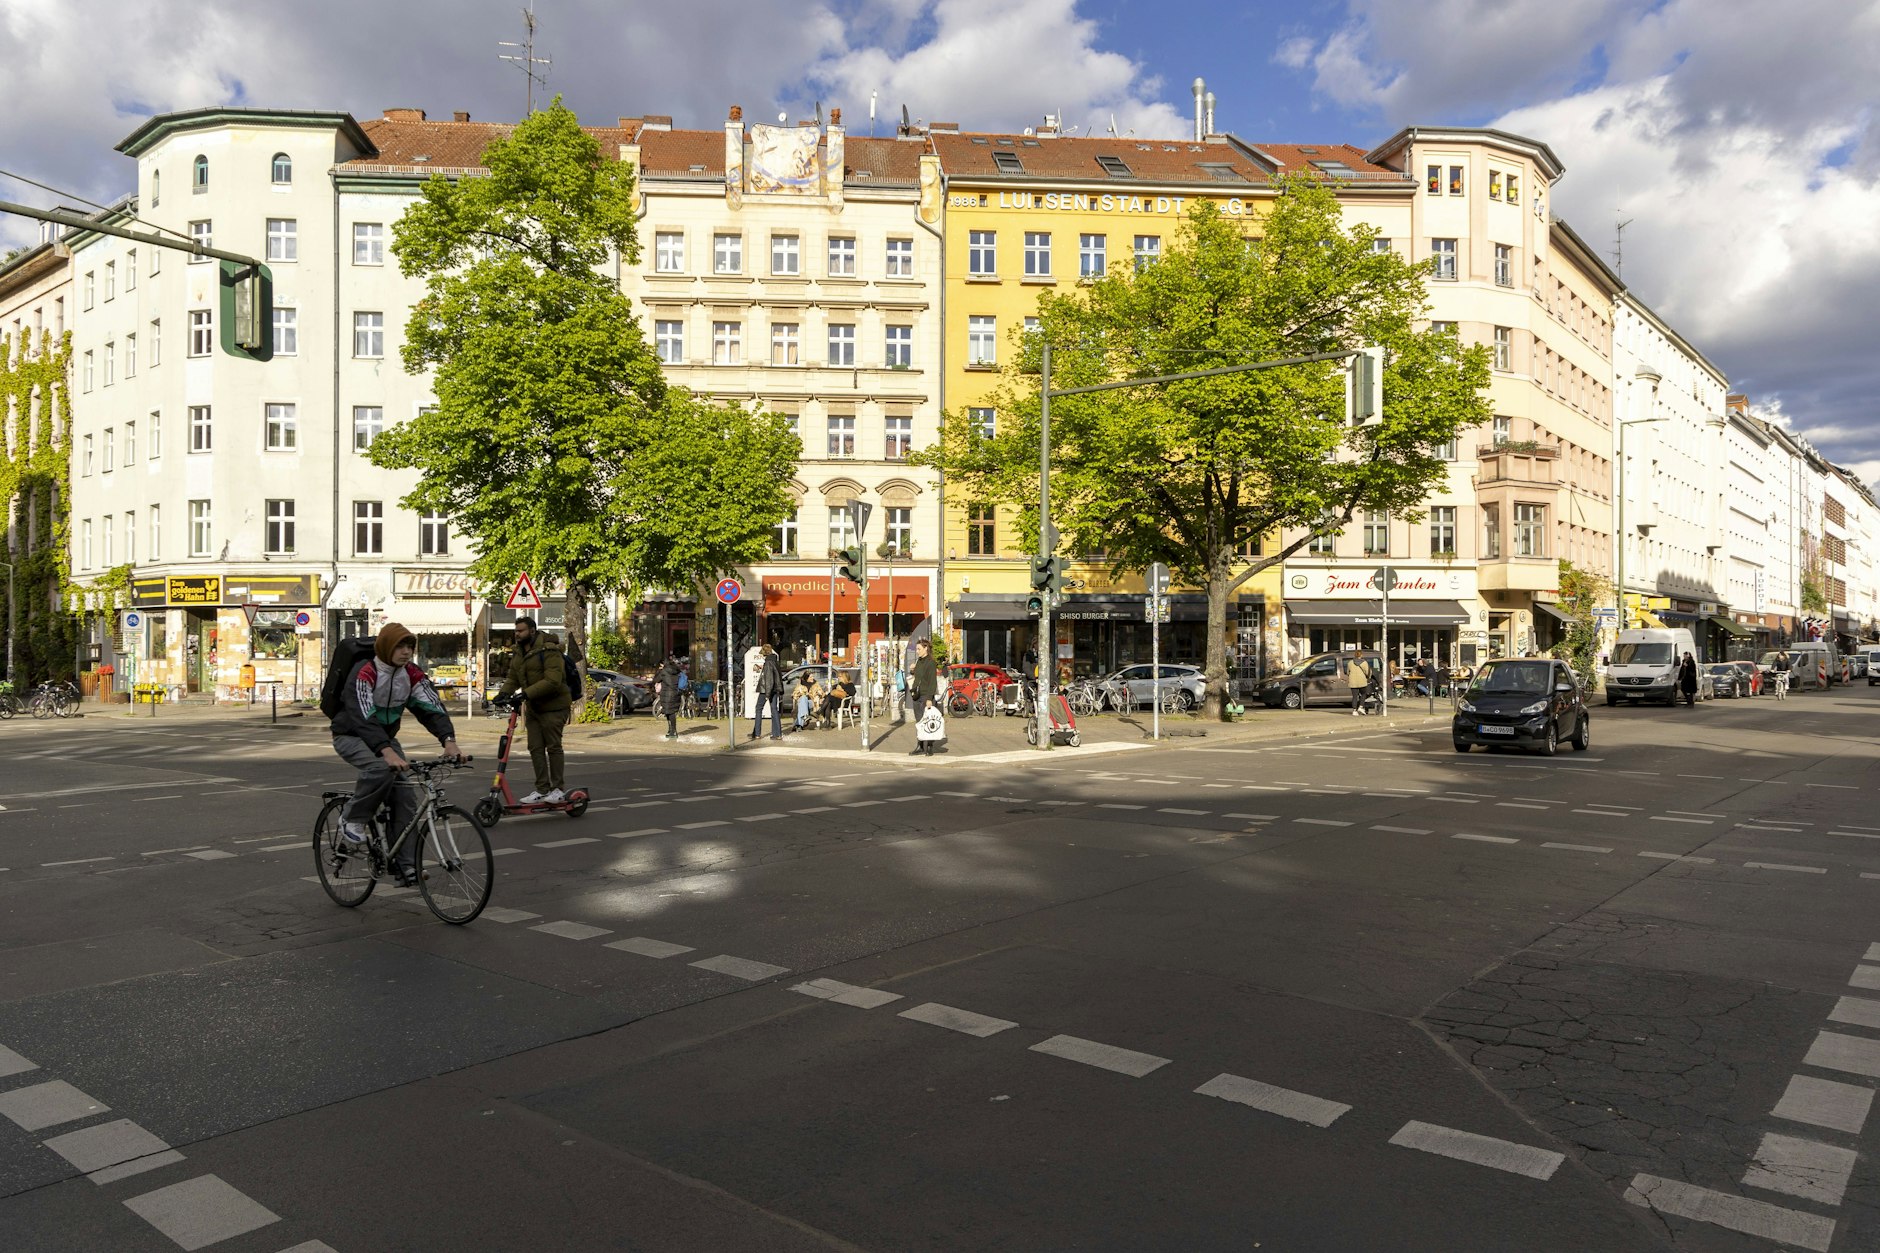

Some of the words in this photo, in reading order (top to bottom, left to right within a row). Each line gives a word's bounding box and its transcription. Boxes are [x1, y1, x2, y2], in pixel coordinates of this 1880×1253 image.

[950, 196, 977, 207] 1986
[1220, 197, 1242, 215] eG
[1325, 575, 1360, 594] Zum
[171, 586, 205, 595] goldenen
[184, 593, 205, 601] Hahn
[1060, 612, 1081, 620] SHISO
[1082, 612, 1109, 620] BURGER
